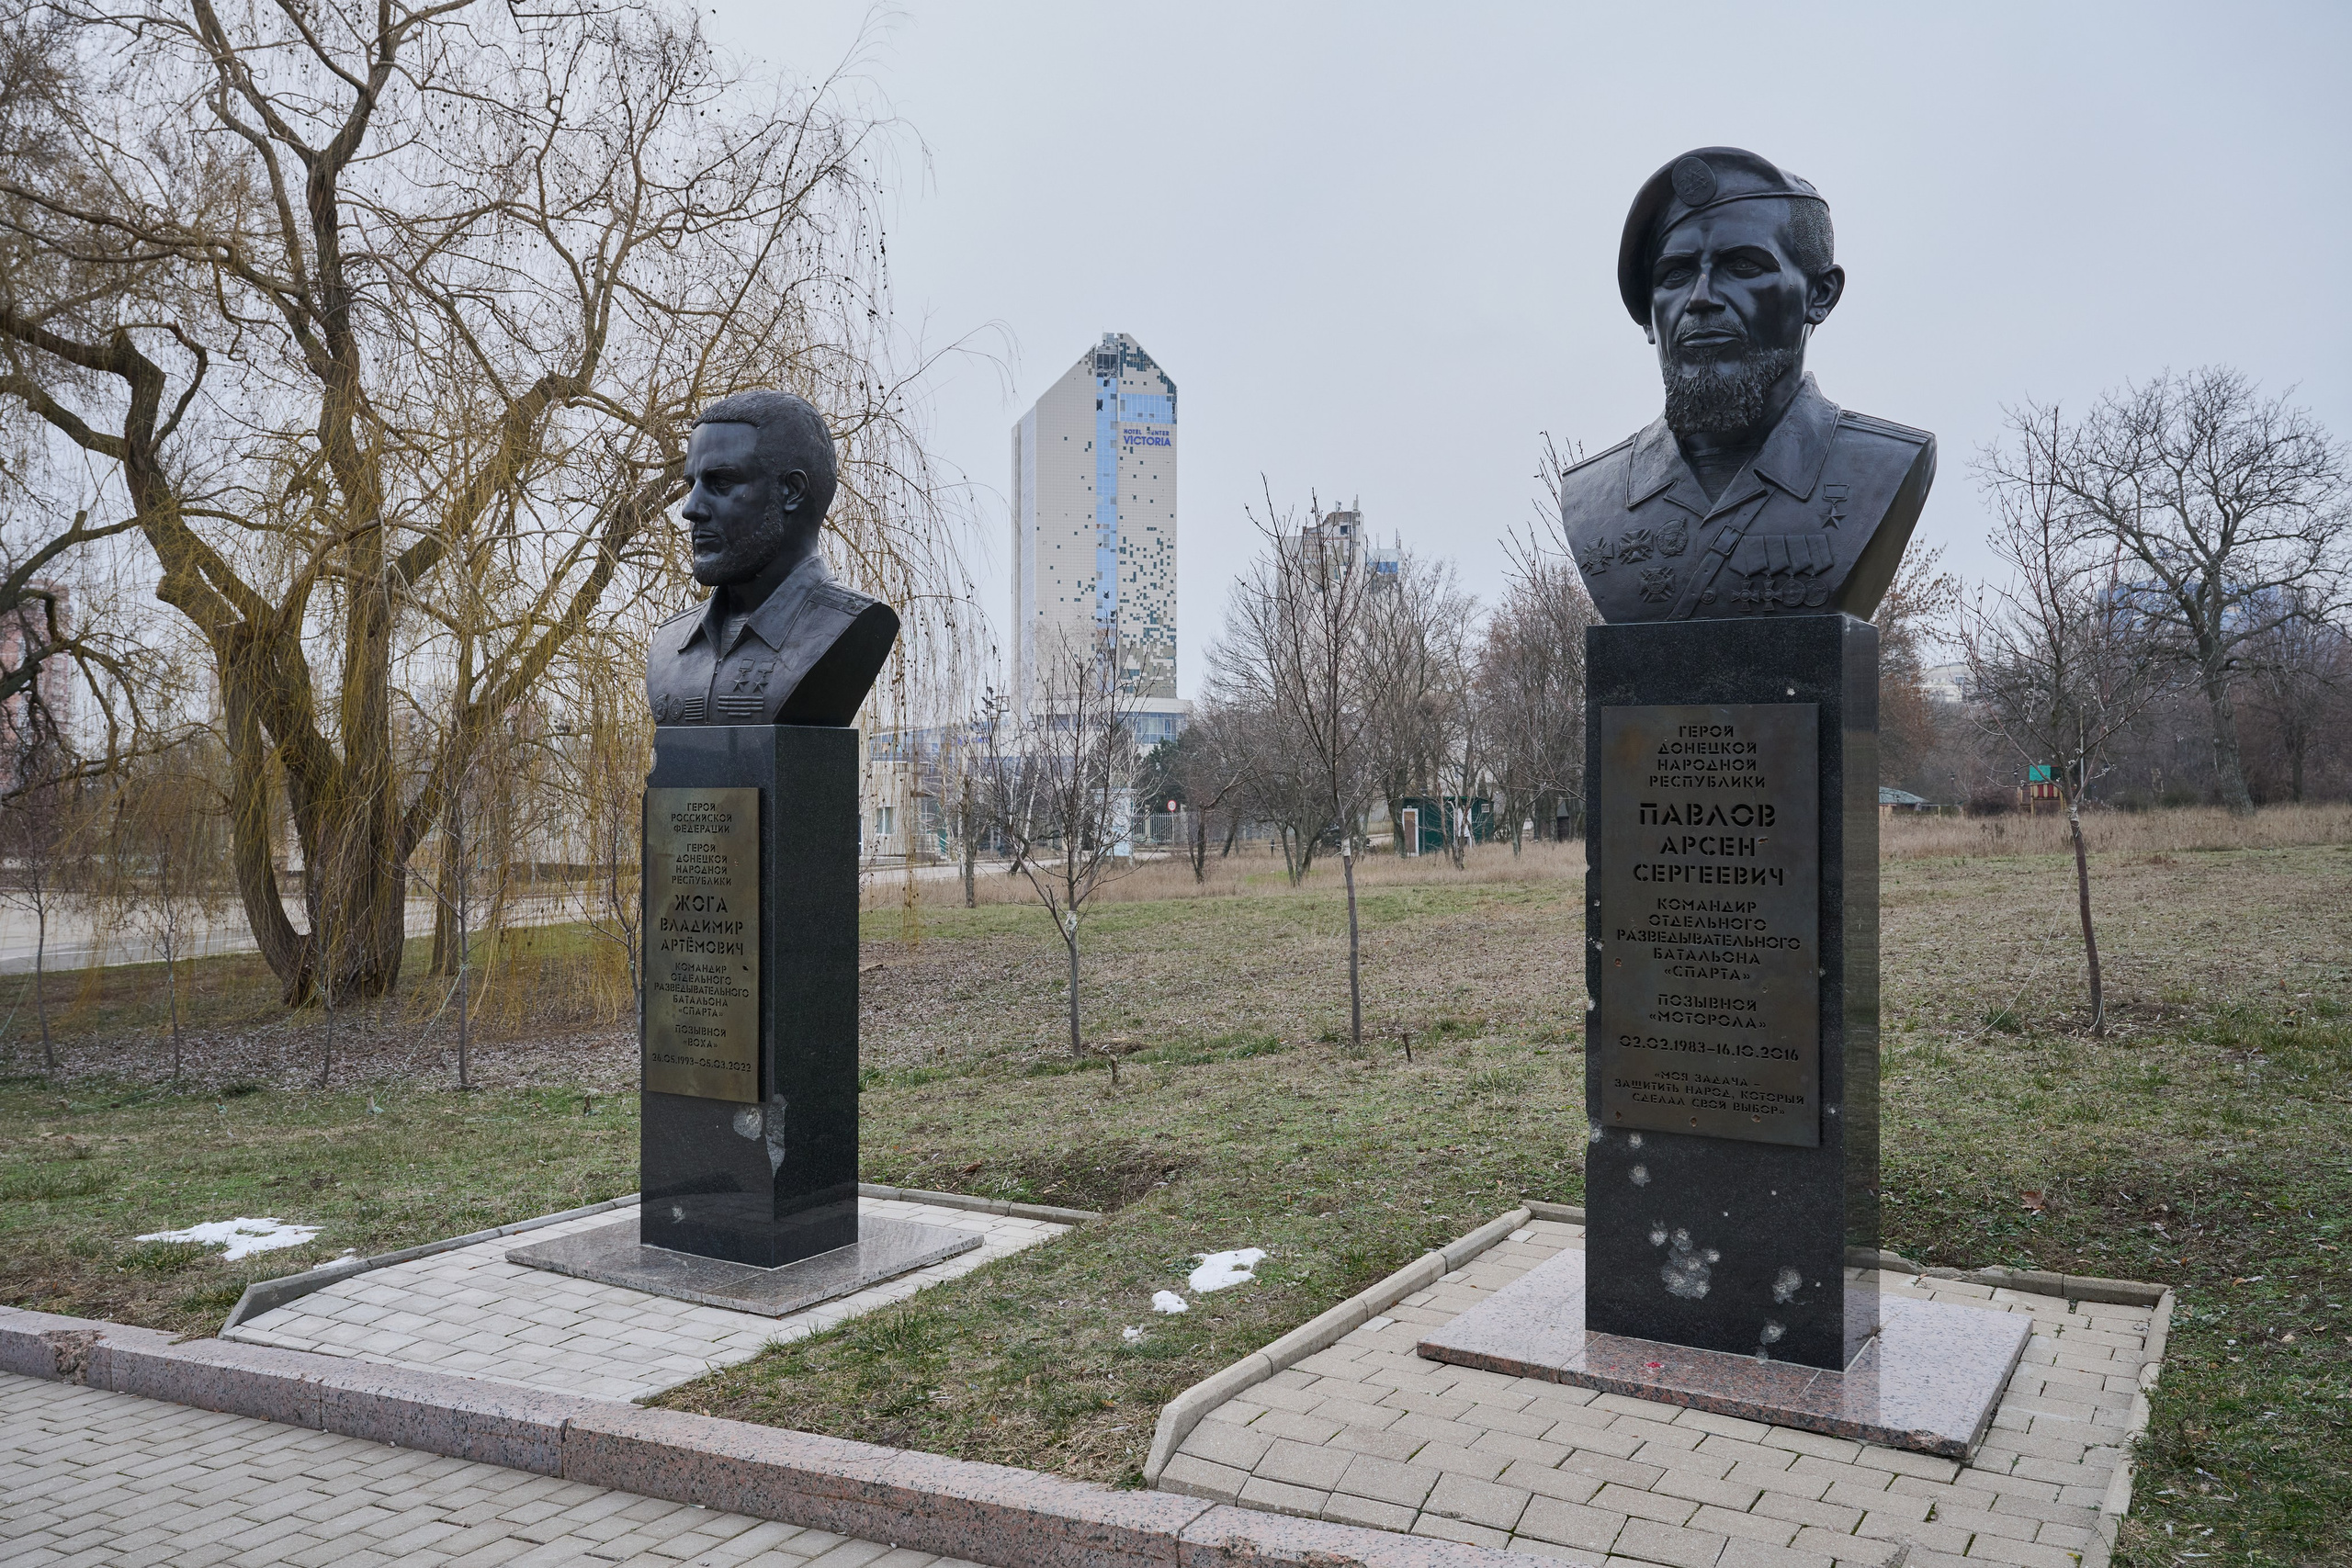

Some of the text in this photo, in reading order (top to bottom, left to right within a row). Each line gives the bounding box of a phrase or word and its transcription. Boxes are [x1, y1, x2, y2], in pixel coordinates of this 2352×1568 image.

[1124, 435, 1171, 446] VICTORIA
[1679, 726, 1734, 738] ГЕРОЙ
[1657, 742, 1757, 754] ДОНЕЦКОЙ
[1657, 759, 1757, 771] НАРОДНОЙ
[1649, 775, 1765, 788] РЕСПУБЛИКИ
[687, 803, 716, 811] ГЕРОЙ
[672, 814, 731, 822] РОССИЙСКОЙ
[1640, 803, 1775, 827] ПАВЛОВ
[673, 825, 729, 833] ФЕДЕРАЦИИ
[687, 843, 716, 852] ГЕРОЙ
[1660, 836, 1755, 856] АРСЕН
[676, 854, 727, 863] ДОНЕЦКОЙ
[676, 865, 727, 874] НАРОДНОЙ
[1634, 863, 1783, 886] СЕРГЕЕВИЧ
[672, 875, 731, 886] РЕСПУБЛИКИ
[675, 895, 728, 912] ЖОГА
[1657, 898, 1757, 913] КОМАНДИР
[661, 918, 743, 934] ВЛАДИМИР
[1649, 914, 1767, 931] ОТДЕЛЬНОГО
[661, 937, 743, 955] АРТЁМОВИЧ
[1617, 930, 1801, 950] РАЗВЕДЫВАТЕЛЬНОГО
[1654, 948, 1761, 965] БАТАЛЬОНА
[675, 963, 727, 973] КОМАНДИР
[1665, 965, 1750, 980] «СПАРТА»
[671, 973, 731, 985] ОТДЕЛЬНОГО
[655, 983, 749, 998] РАЗВЕДЫВАТЕЛЬНОГО
[673, 995, 729, 1007] БАТАЛЬОНА
[1658, 994, 1757, 1011] ПОЗЫВНОЙ
[679, 1007, 723, 1017] «СПАРТА»
[1649, 1011, 1766, 1029] «МОТОРОЛА»
[675, 1025, 726, 1037] ПОЗЫВНОЙ
[684, 1038, 718, 1048] «ВОХА»
[1655, 1071, 1688, 1081] «МОЯ
[1695, 1074, 1747, 1087] ЗАДАЧА
[1615, 1078, 1804, 1104] ЗАЩИТИТЬ НАРОД, КОТОРЫЙ
[1633, 1093, 1784, 1115] СДЕЛАЛ СВОЙ ВЫБОР»
